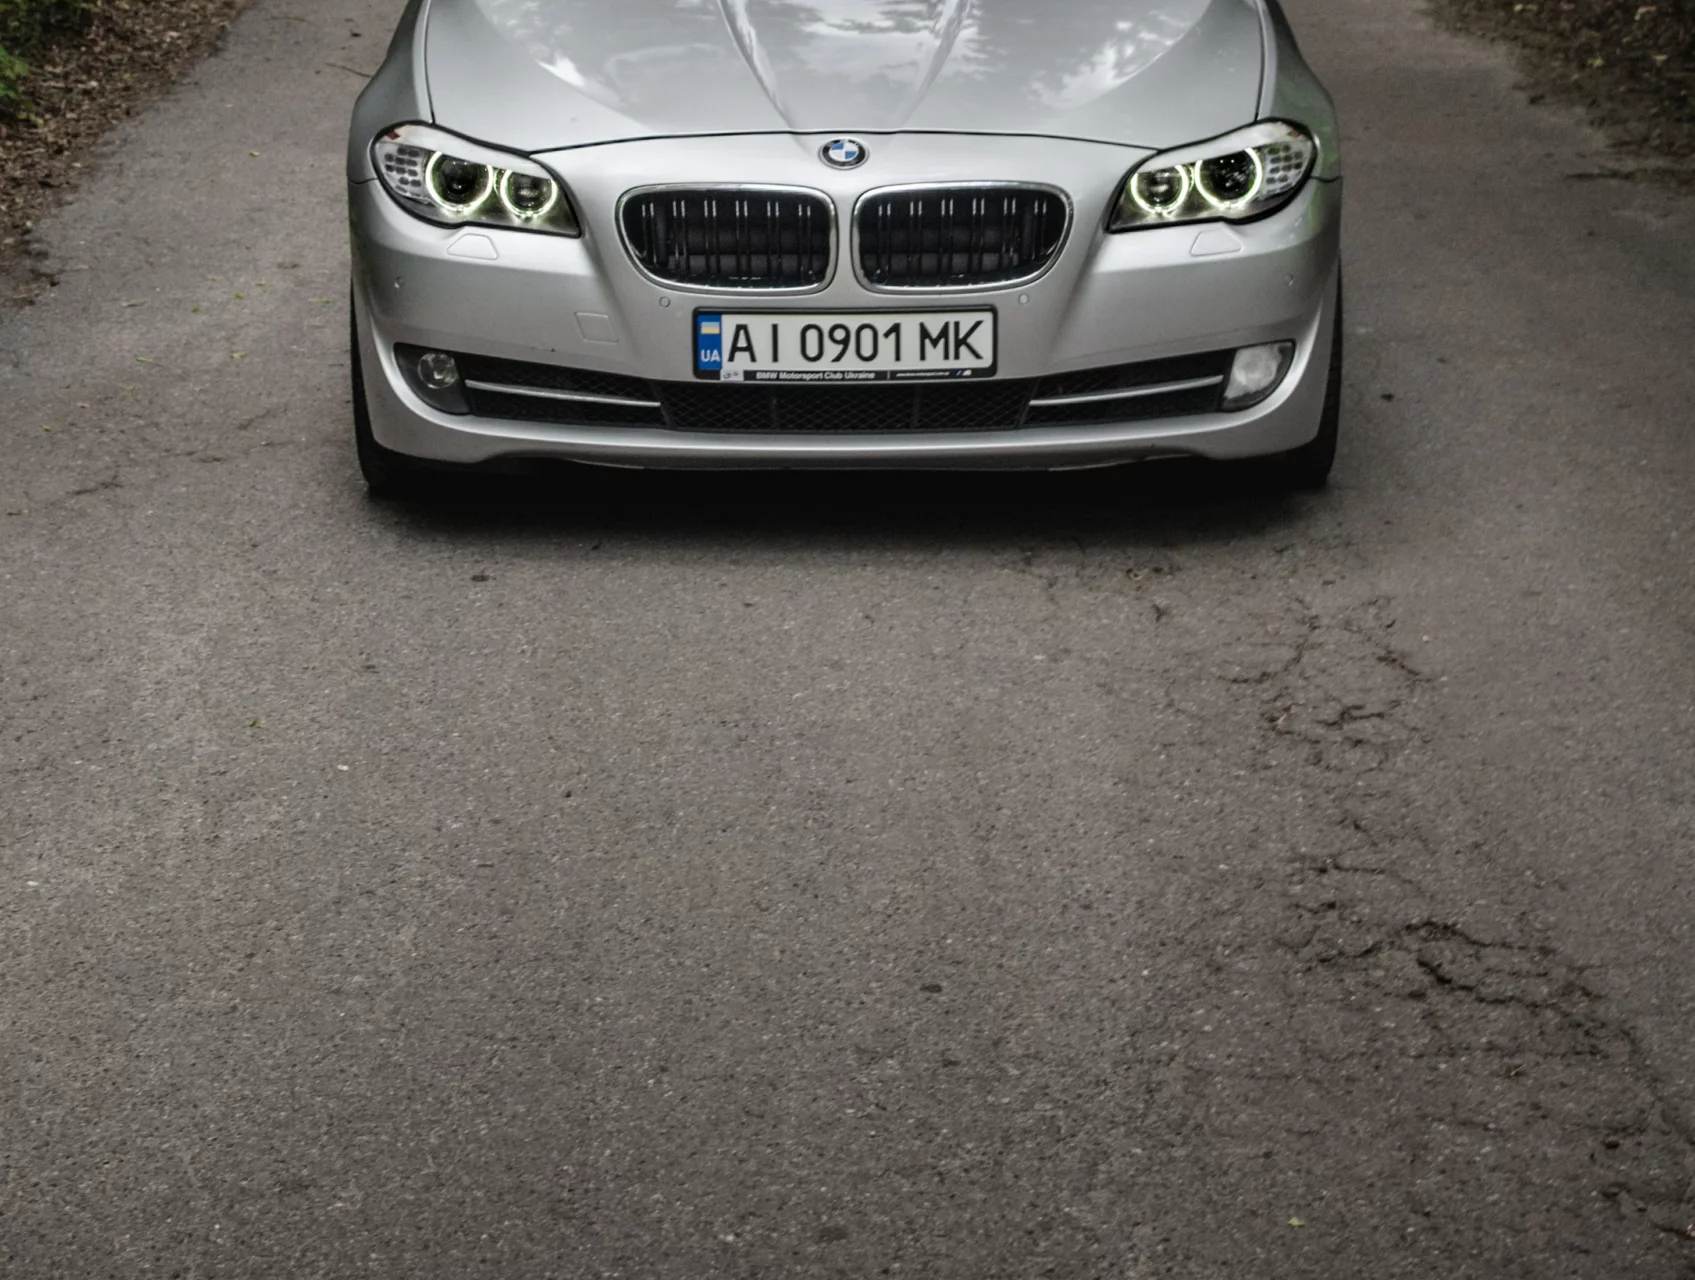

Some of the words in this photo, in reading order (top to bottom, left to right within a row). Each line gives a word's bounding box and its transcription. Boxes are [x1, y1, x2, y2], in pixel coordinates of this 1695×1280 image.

[727, 323, 779, 363] AI
[800, 322, 901, 363] 0901
[919, 320, 984, 362] MK
[701, 349, 721, 363] UA
[756, 371, 778, 380] BMW
[779, 371, 823, 381] Motorsport
[824, 371, 843, 380] Club
[844, 371, 875, 380] Ukraine
